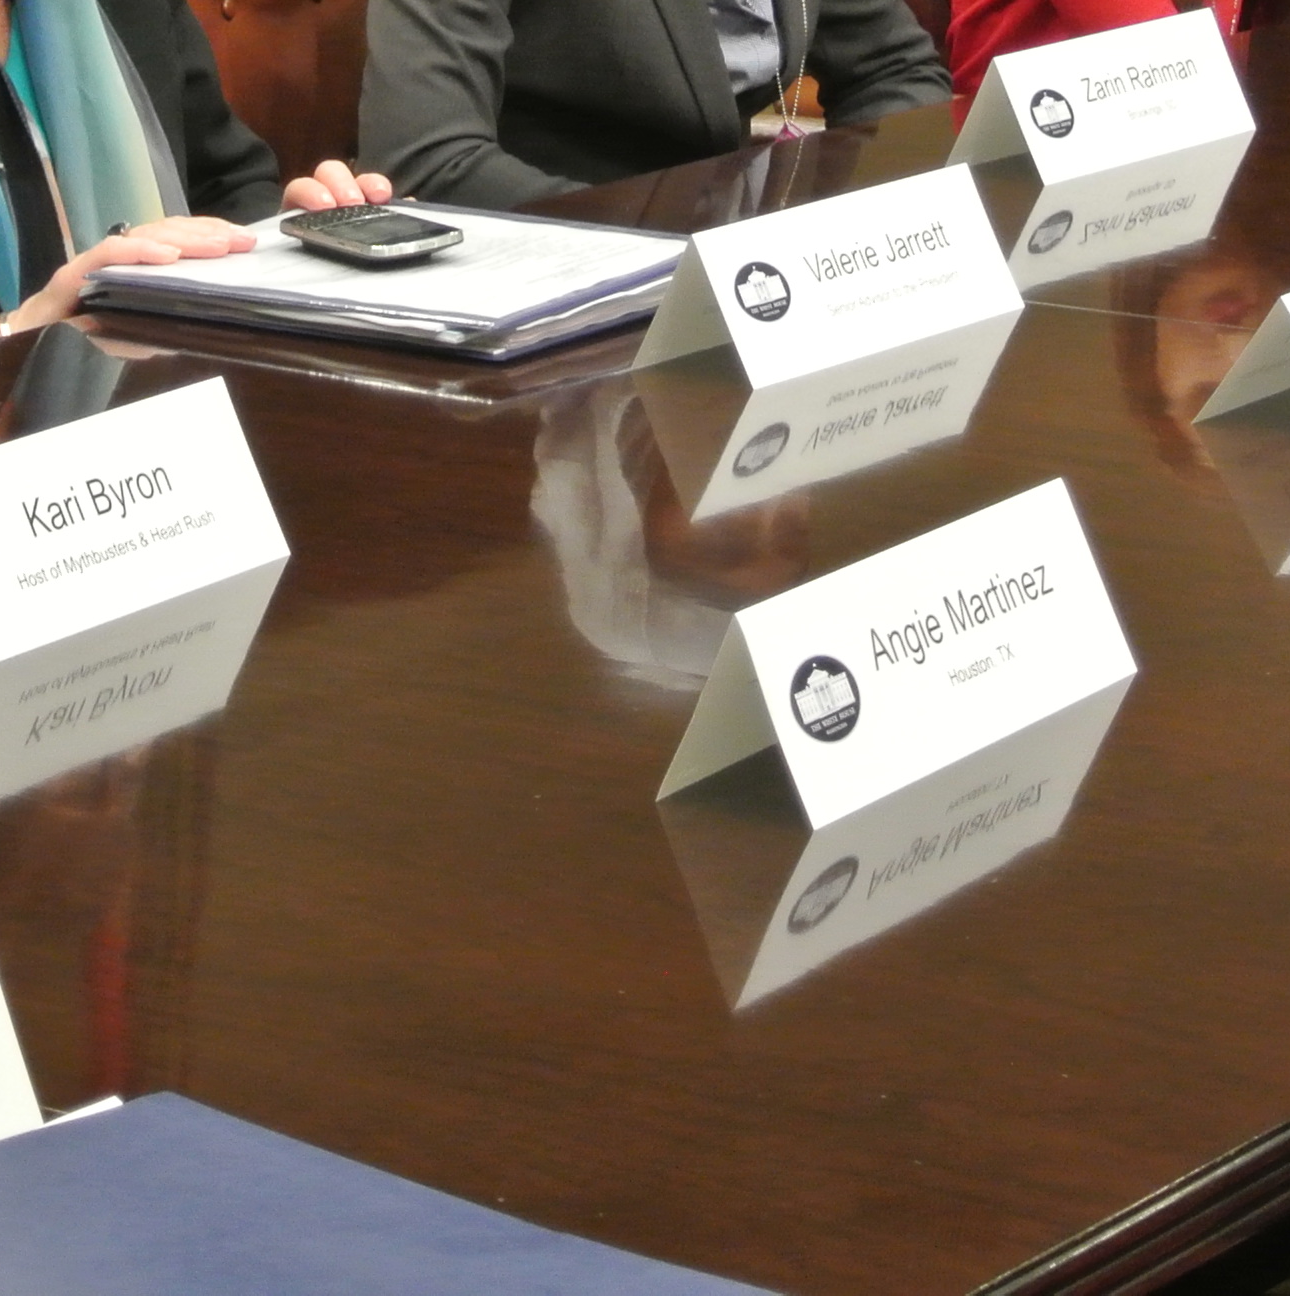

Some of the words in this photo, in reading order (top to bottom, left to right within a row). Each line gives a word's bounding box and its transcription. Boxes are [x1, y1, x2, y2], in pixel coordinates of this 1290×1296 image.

[1080, 73, 1127, 103] Zarin
[1126, 58, 1198, 91] Rahman
[803, 241, 880, 283] Valerie
[886, 221, 950, 263] Jarrett
[22, 486, 85, 537] Kari
[85, 467, 172, 519] Byron
[17, 566, 49, 590] Host
[50, 563, 62, 580] of
[63, 539, 137, 575] Mythbusters
[138, 532, 149, 547] &
[150, 518, 183, 542] Head
[183, 509, 216, 532] Rush
[869, 609, 944, 671] Angie
[942, 565, 1054, 635] Martinez
[996, 643, 1015, 662] TX
